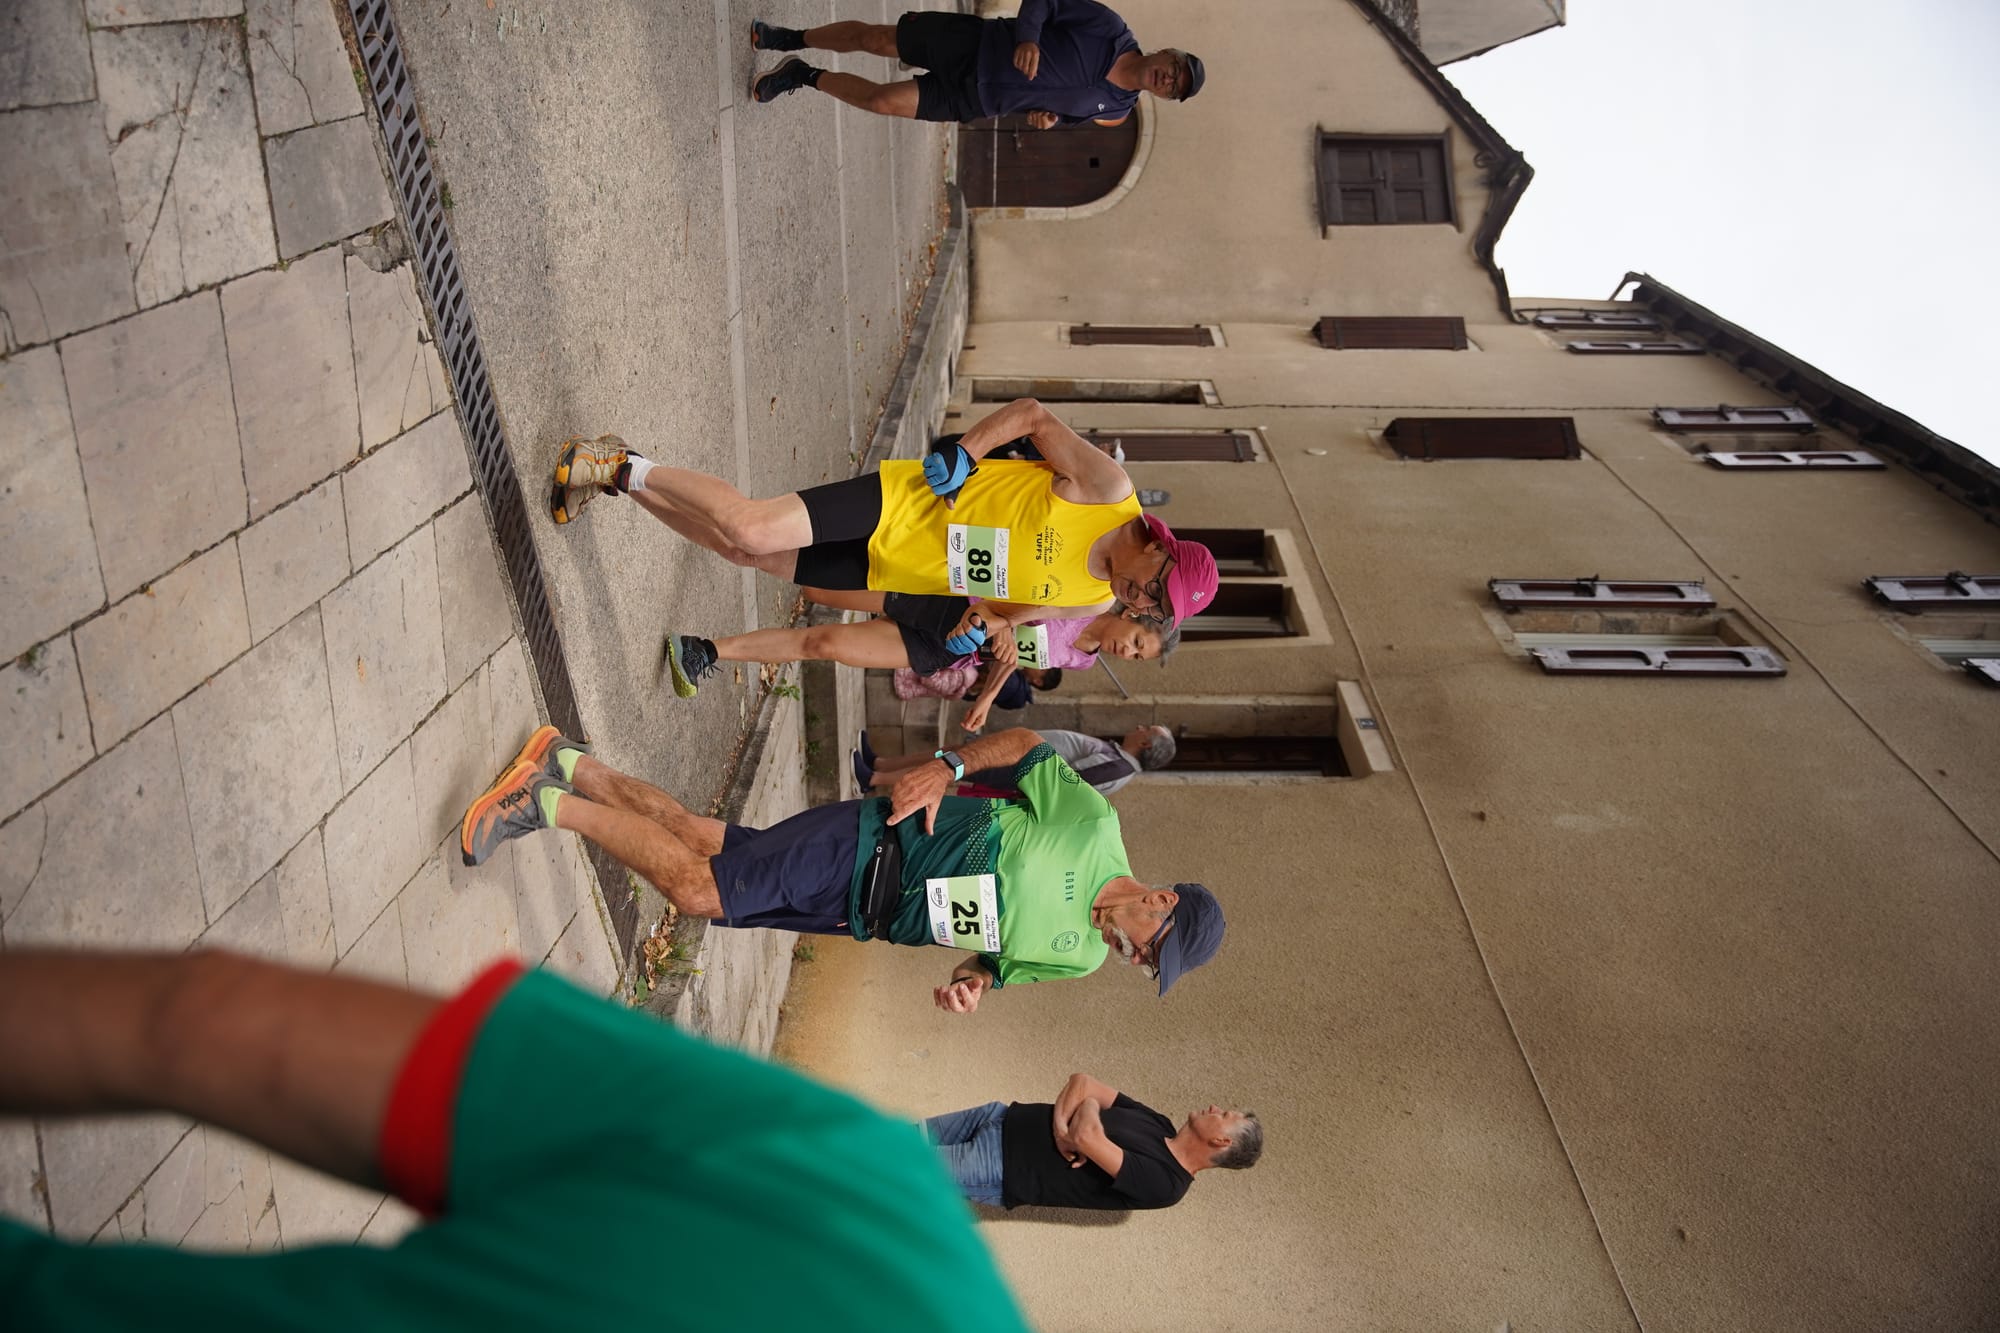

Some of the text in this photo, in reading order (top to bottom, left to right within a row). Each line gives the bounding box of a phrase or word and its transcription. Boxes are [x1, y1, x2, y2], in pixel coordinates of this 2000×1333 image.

[1035, 532, 1043, 561] TUFF'S
[968, 548, 992, 583] 89
[1017, 640, 1036, 663] 37
[497, 787, 530, 810] HOKA
[1065, 872, 1075, 902] GOBIK
[951, 900, 980, 935] 25
